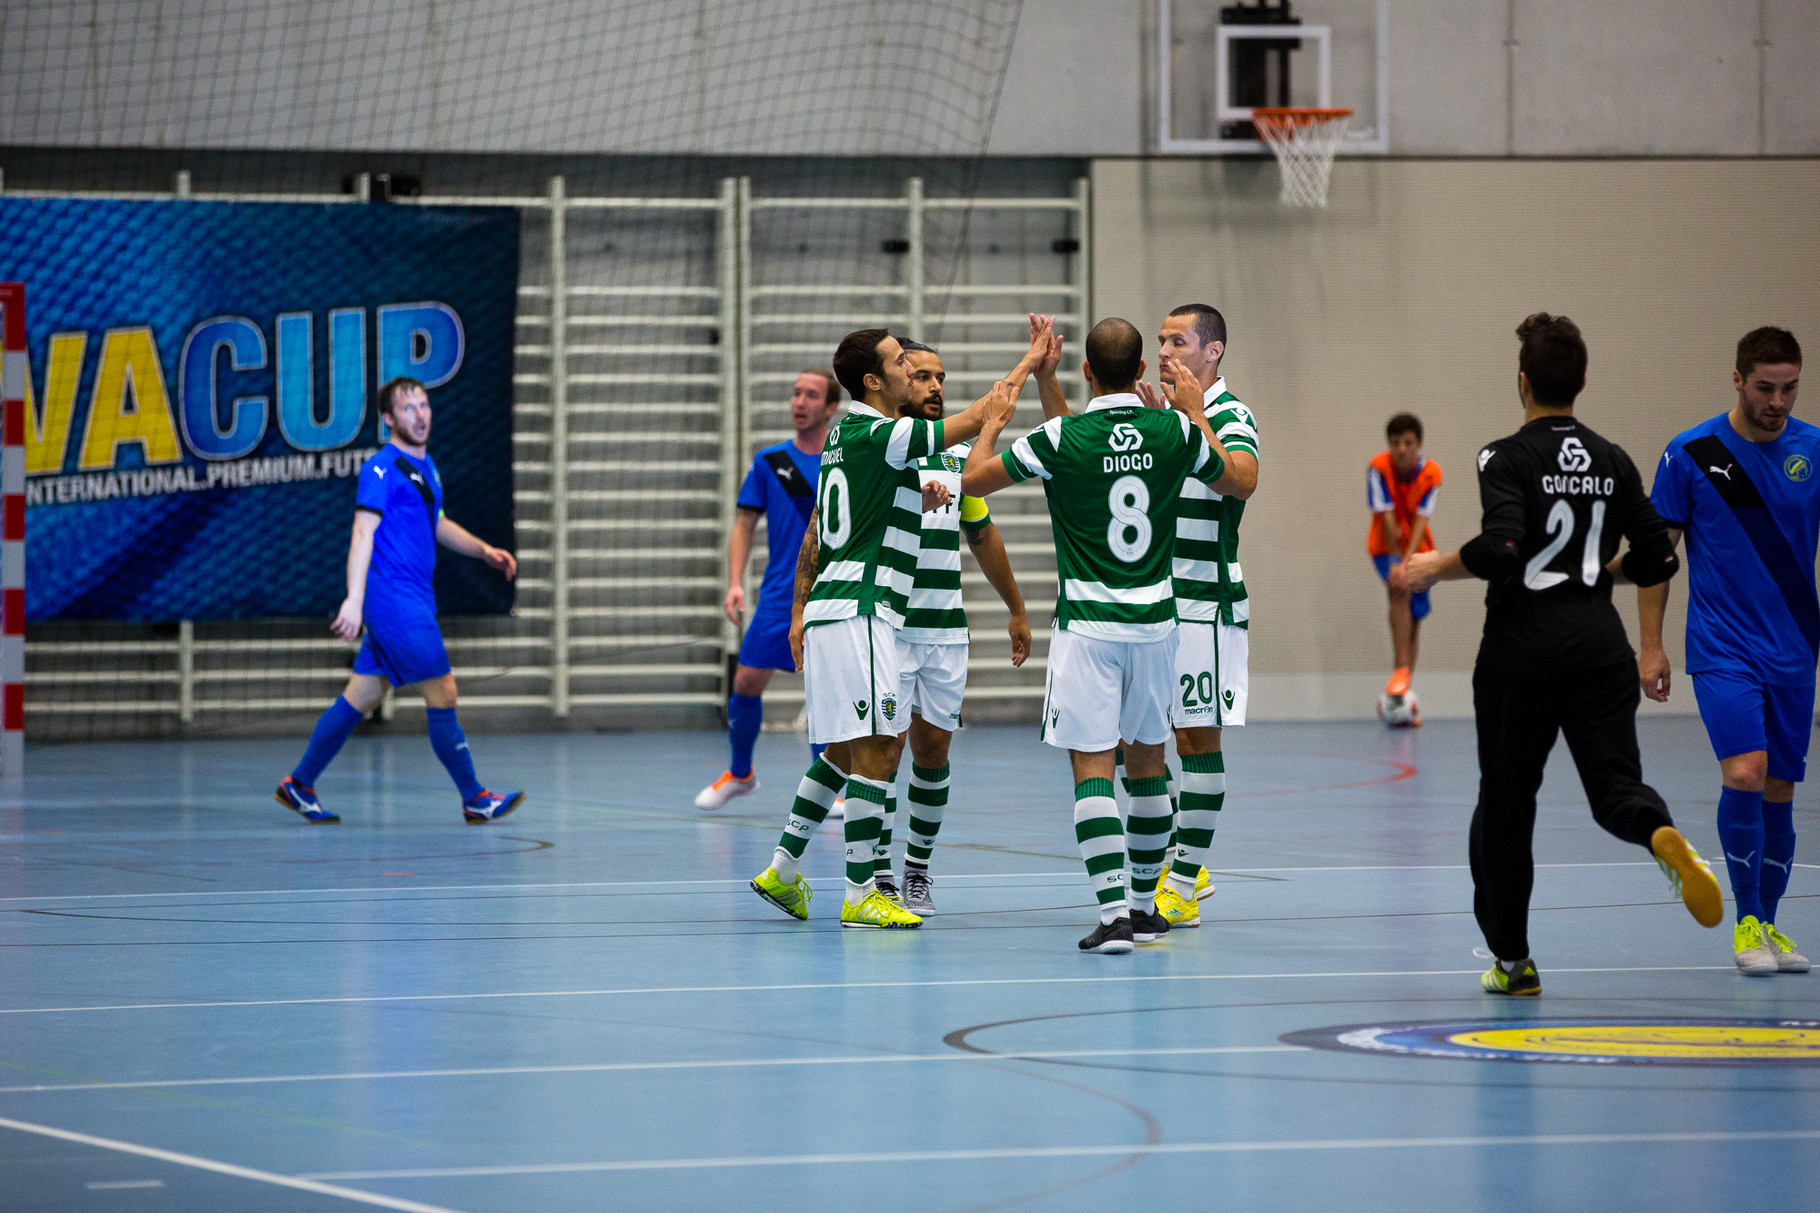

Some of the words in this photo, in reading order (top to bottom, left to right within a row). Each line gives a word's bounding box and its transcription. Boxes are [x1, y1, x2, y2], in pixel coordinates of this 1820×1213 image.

[1103, 453, 1153, 473] DIOGO
[1107, 474, 1153, 563] 8
[1523, 499, 1607, 591] 21
[1179, 671, 1213, 707] 20
[1185, 705, 1213, 715] macron
[786, 819, 809, 831] SCP
